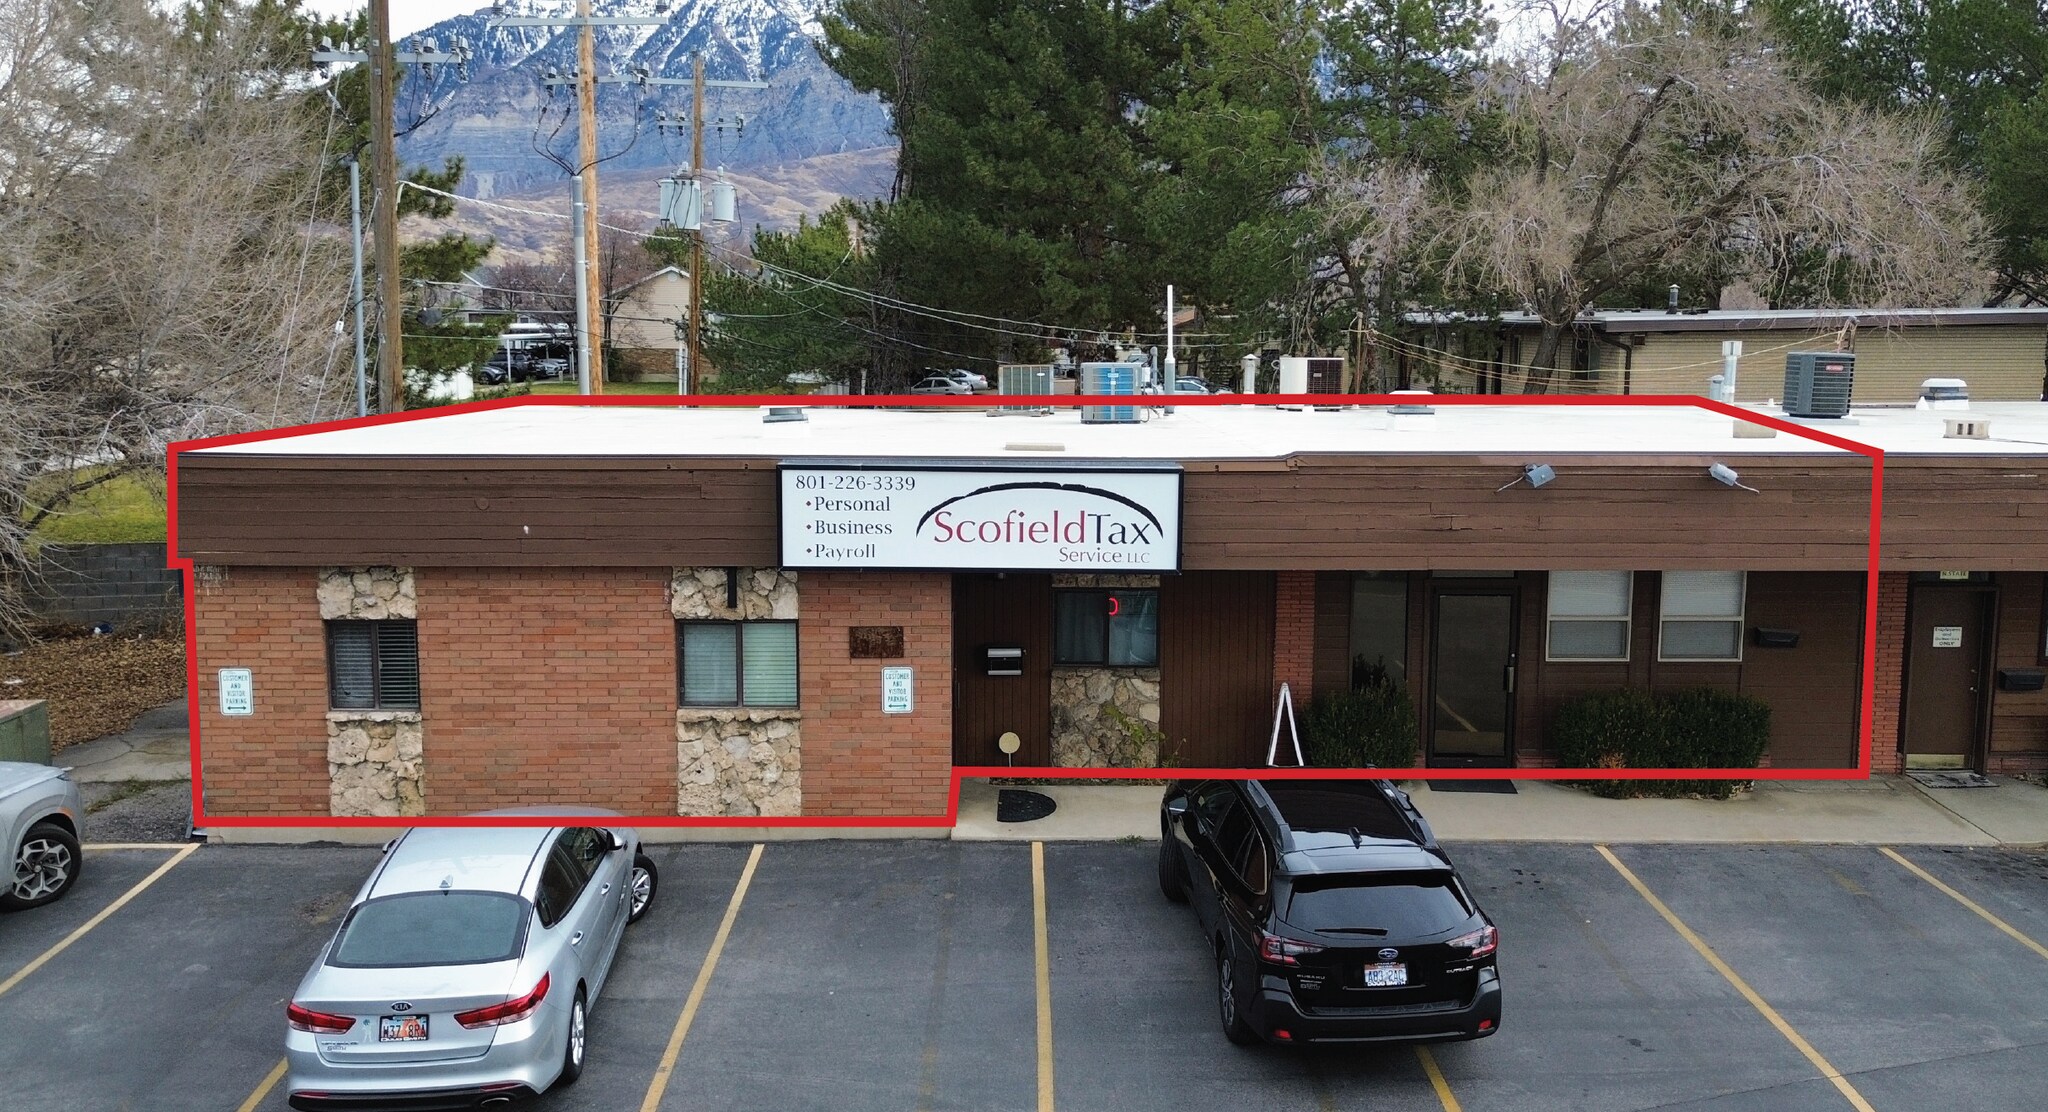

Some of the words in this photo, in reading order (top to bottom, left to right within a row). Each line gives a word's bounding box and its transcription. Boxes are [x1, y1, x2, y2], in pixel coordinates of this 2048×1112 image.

[796, 475, 916, 491] 801-226-3339
[814, 496, 891, 511] Personal
[815, 520, 893, 534] Business
[815, 543, 875, 561] Payroll
[1059, 547, 1122, 563] Service
[1127, 552, 1150, 563] LLC
